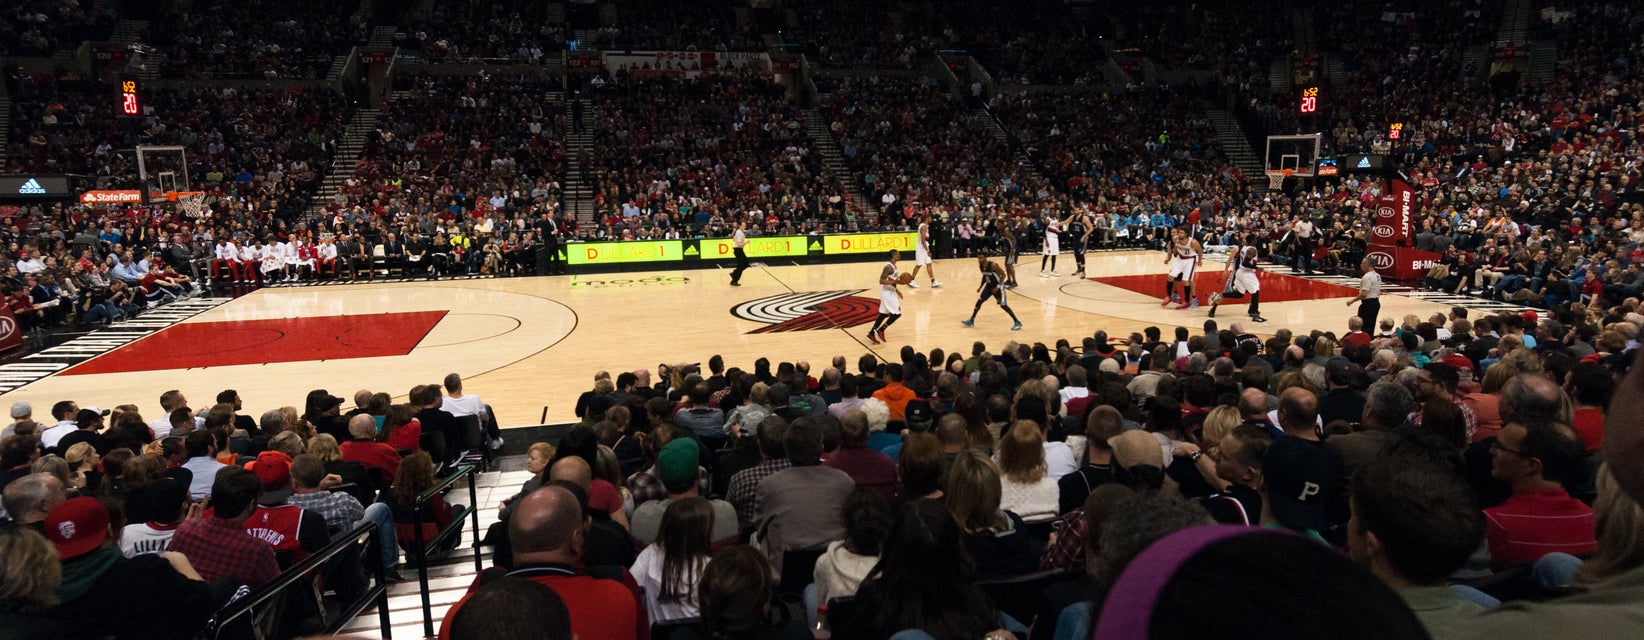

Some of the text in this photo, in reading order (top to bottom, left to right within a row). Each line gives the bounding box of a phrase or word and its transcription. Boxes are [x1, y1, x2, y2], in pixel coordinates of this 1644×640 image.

[122, 93, 138, 114] 20
[1301, 97, 1316, 113] 20
[1390, 130, 1400, 139] 20
[1297, 480, 1321, 502] P
